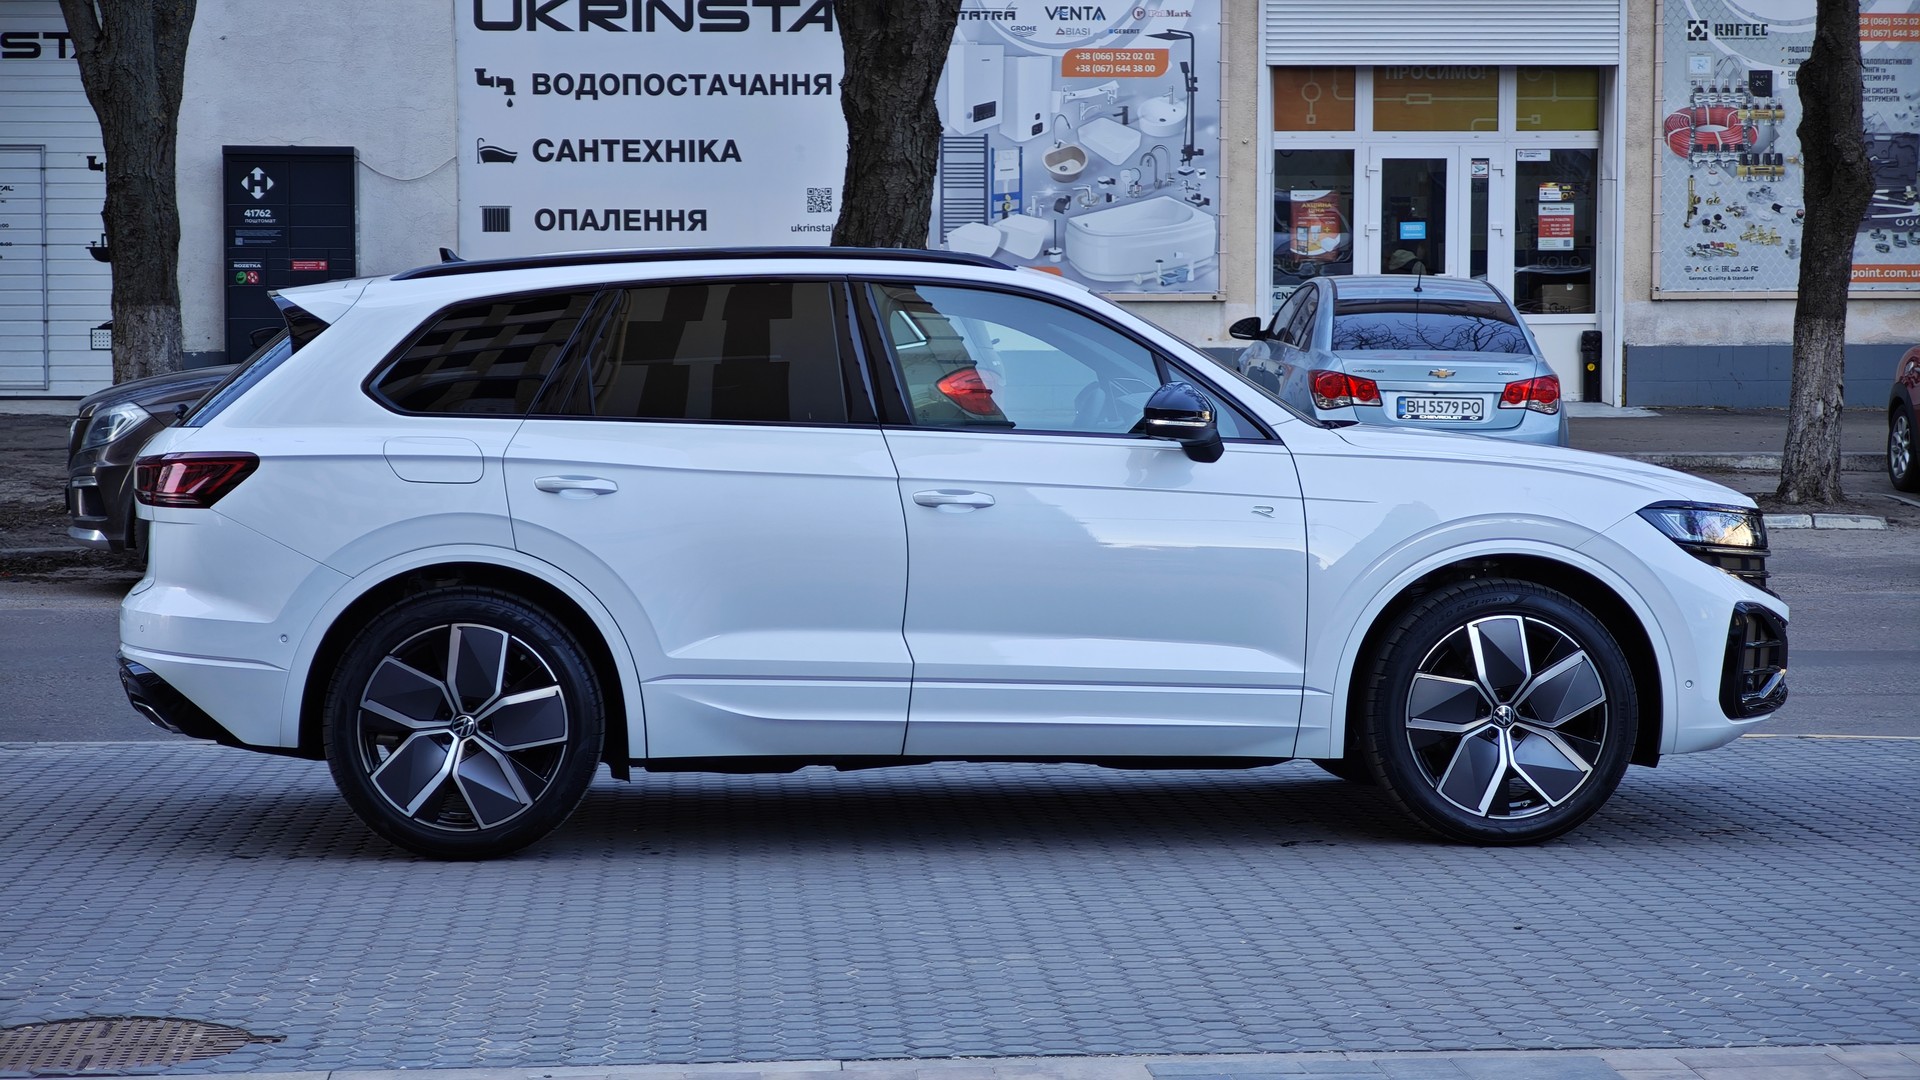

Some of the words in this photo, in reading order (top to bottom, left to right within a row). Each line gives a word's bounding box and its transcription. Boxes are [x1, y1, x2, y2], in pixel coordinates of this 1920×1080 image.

[473, 0, 833, 32] UKRINSTA
[957, 11, 1016, 20] TATRA
[1044, 6, 1106, 21] VENTA
[1148, 9, 1192, 18] PolMark
[1859, 17, 1869, 26] 38
[1870, 17, 1891, 27] (066)
[1892, 17, 1907, 26] 552
[1908, 17, 1919, 26] 02
[1065, 28, 1091, 36] BIASI
[1714, 23, 1769, 37] RAFTEC
[1859, 29, 1869, 38] 38
[1870, 29, 1891, 38] (067)
[1892, 29, 1907, 37] 644
[1908, 29, 1919, 38] 38
[0, 31, 78, 59] ST
[1075, 52, 1091, 60] +38
[1092, 52, 1114, 62] (066)
[1115, 52, 1131, 60] 552
[1132, 52, 1144, 60] 02
[1144, 52, 1155, 60] 01
[1862, 58, 1913, 66] ТАЛОПЛАСТИКОВІ
[1075, 64, 1091, 73] +38
[1092, 64, 1114, 74] (067)
[1115, 64, 1131, 73] 644
[1132, 64, 1143, 73] 38
[1144, 64, 1156, 73] 00
[1385, 65, 1487, 80] ПРОСИМО!
[531, 72, 833, 100] ВОДОПОСТАЧАННЯ
[1862, 95, 1900, 103] НСТРУМЕНТИ
[532, 138, 742, 163] САНТЕХНІКА
[244, 209, 272, 218] 41762
[534, 208, 708, 232] ОПАЛЕННЯ
[790, 223, 834, 232] ukrinstal
[1851, 267, 1920, 280] point.com.u
[1406, 400, 1427, 413] BH
[1430, 400, 1458, 414] 5579
[1461, 401, 1481, 414] PO
